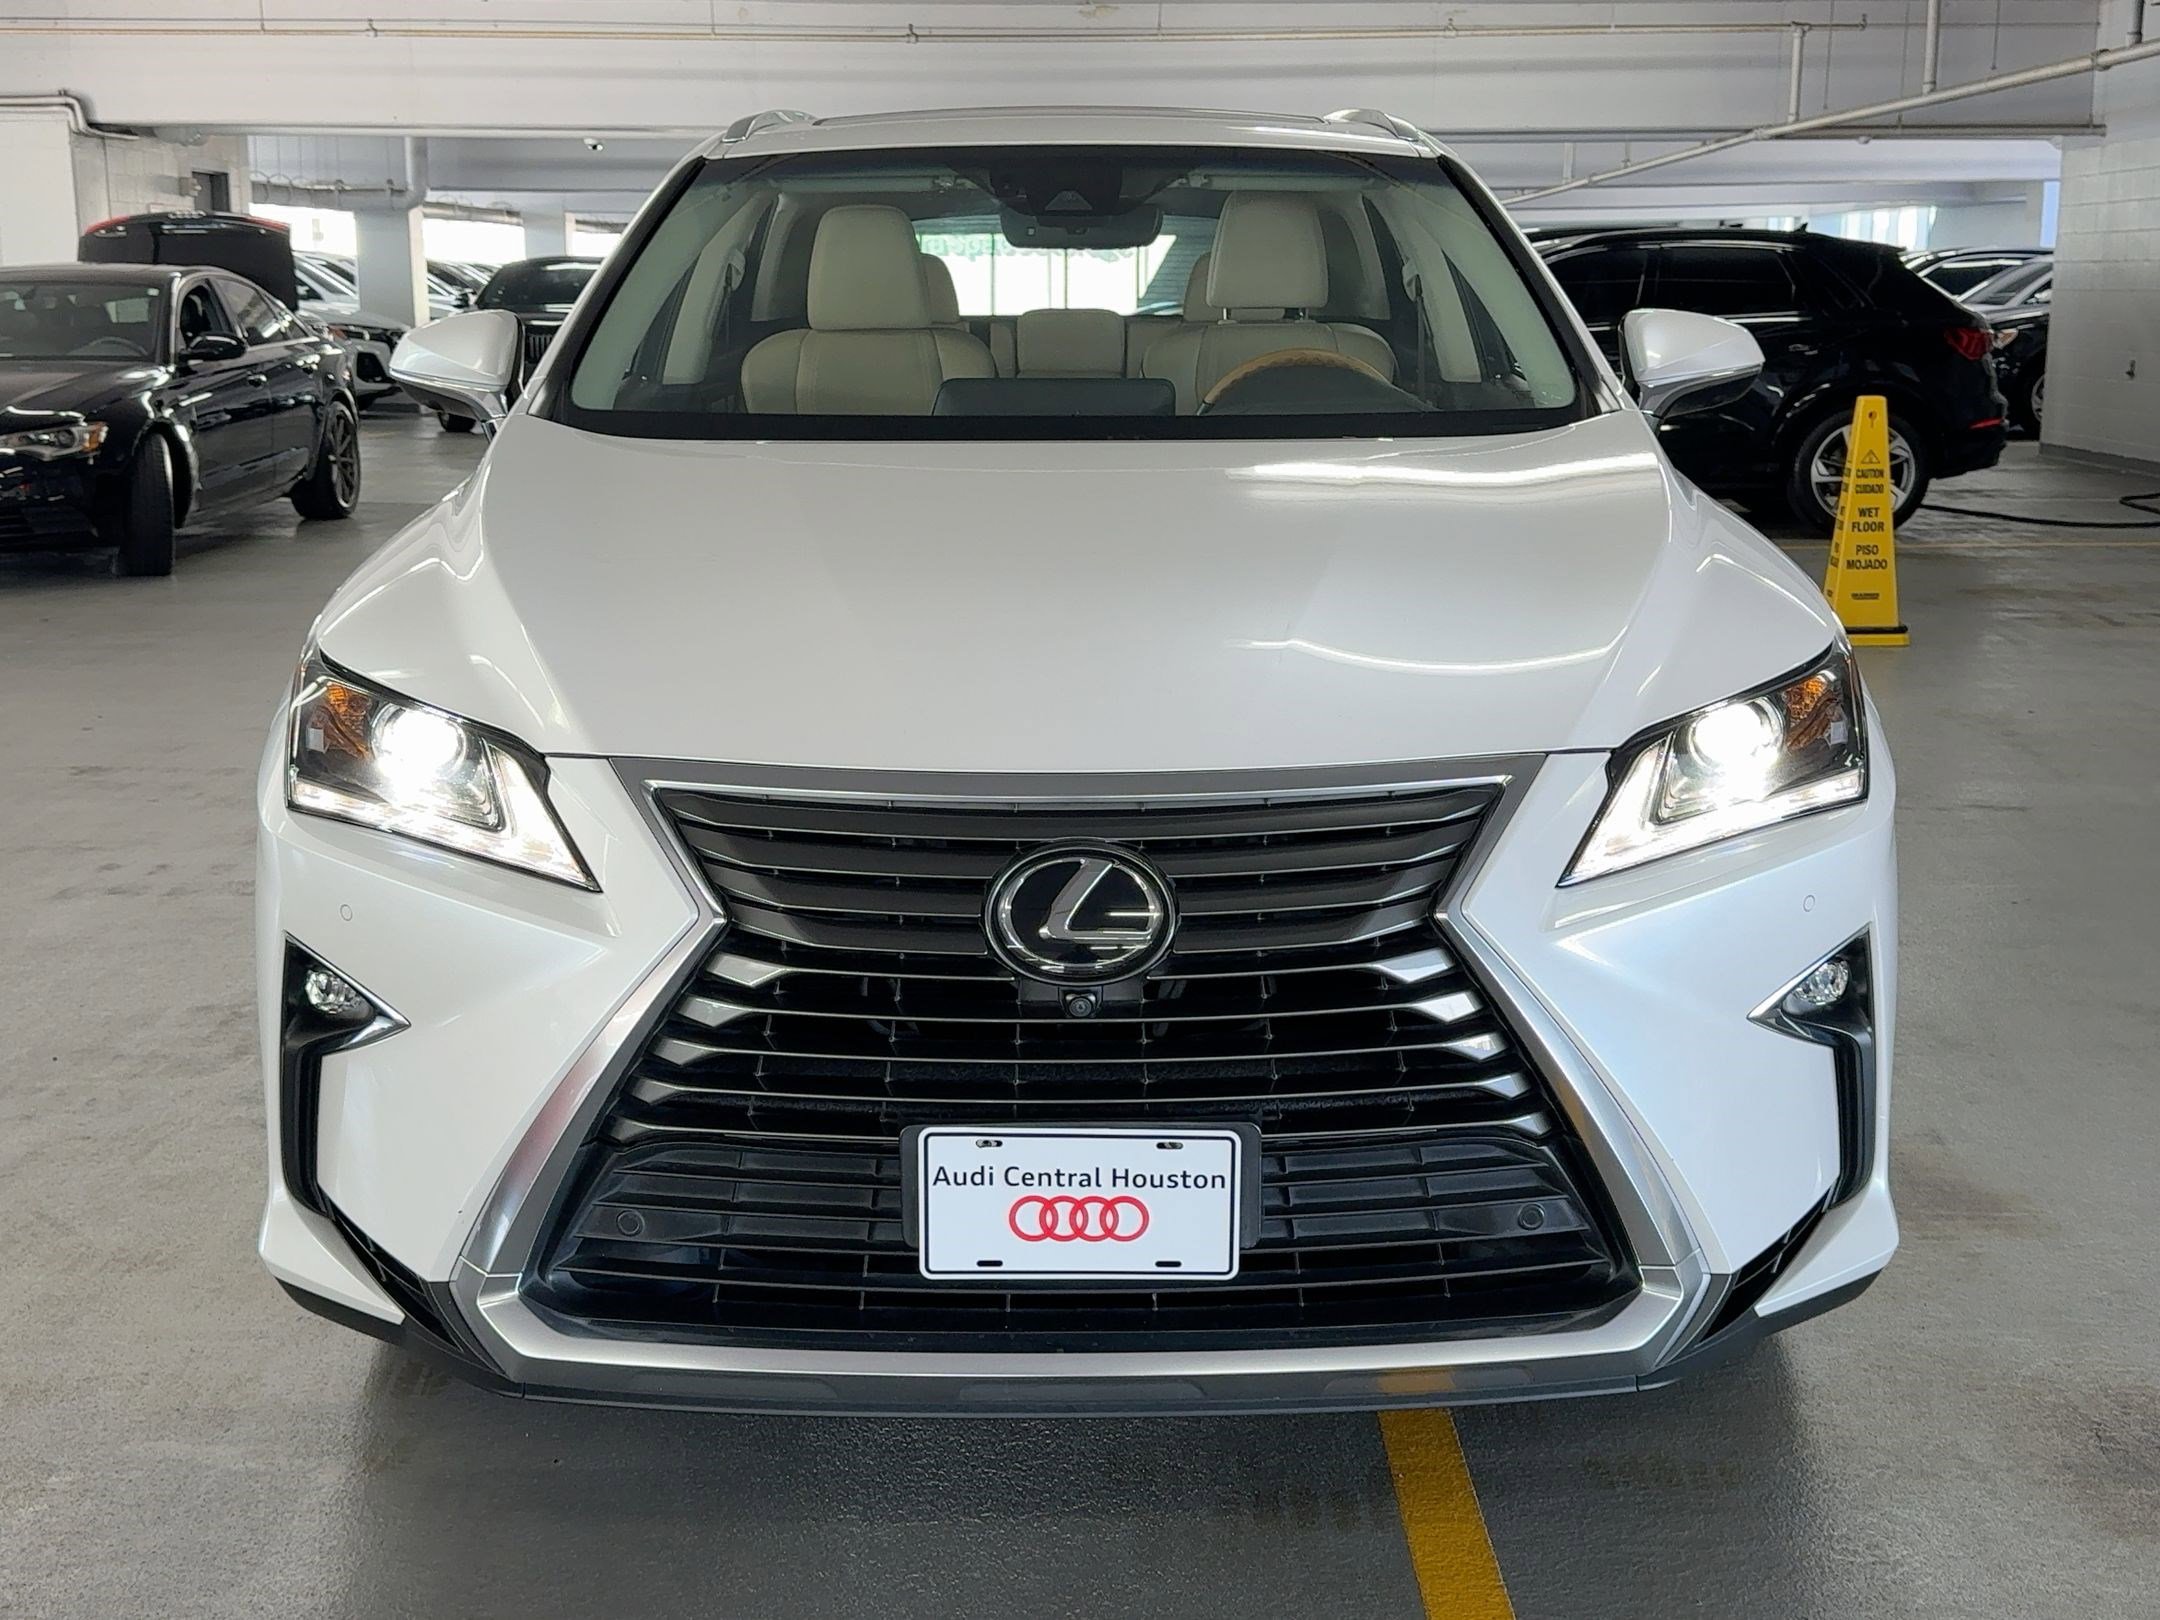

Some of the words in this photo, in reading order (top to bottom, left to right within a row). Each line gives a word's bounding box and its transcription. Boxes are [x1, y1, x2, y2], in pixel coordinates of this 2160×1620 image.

[1855, 468, 1884, 478] CAUTION
[1855, 483, 1884, 494] CUIDADO
[1857, 506, 1880, 517] WET
[1851, 521, 1885, 532] FLOOR
[1855, 544, 1879, 555] PISO
[1846, 559, 1888, 570] MOJADO
[932, 1165, 994, 1187] Audi
[1004, 1166, 1102, 1188] Central
[1112, 1168, 1226, 1190] Houston
